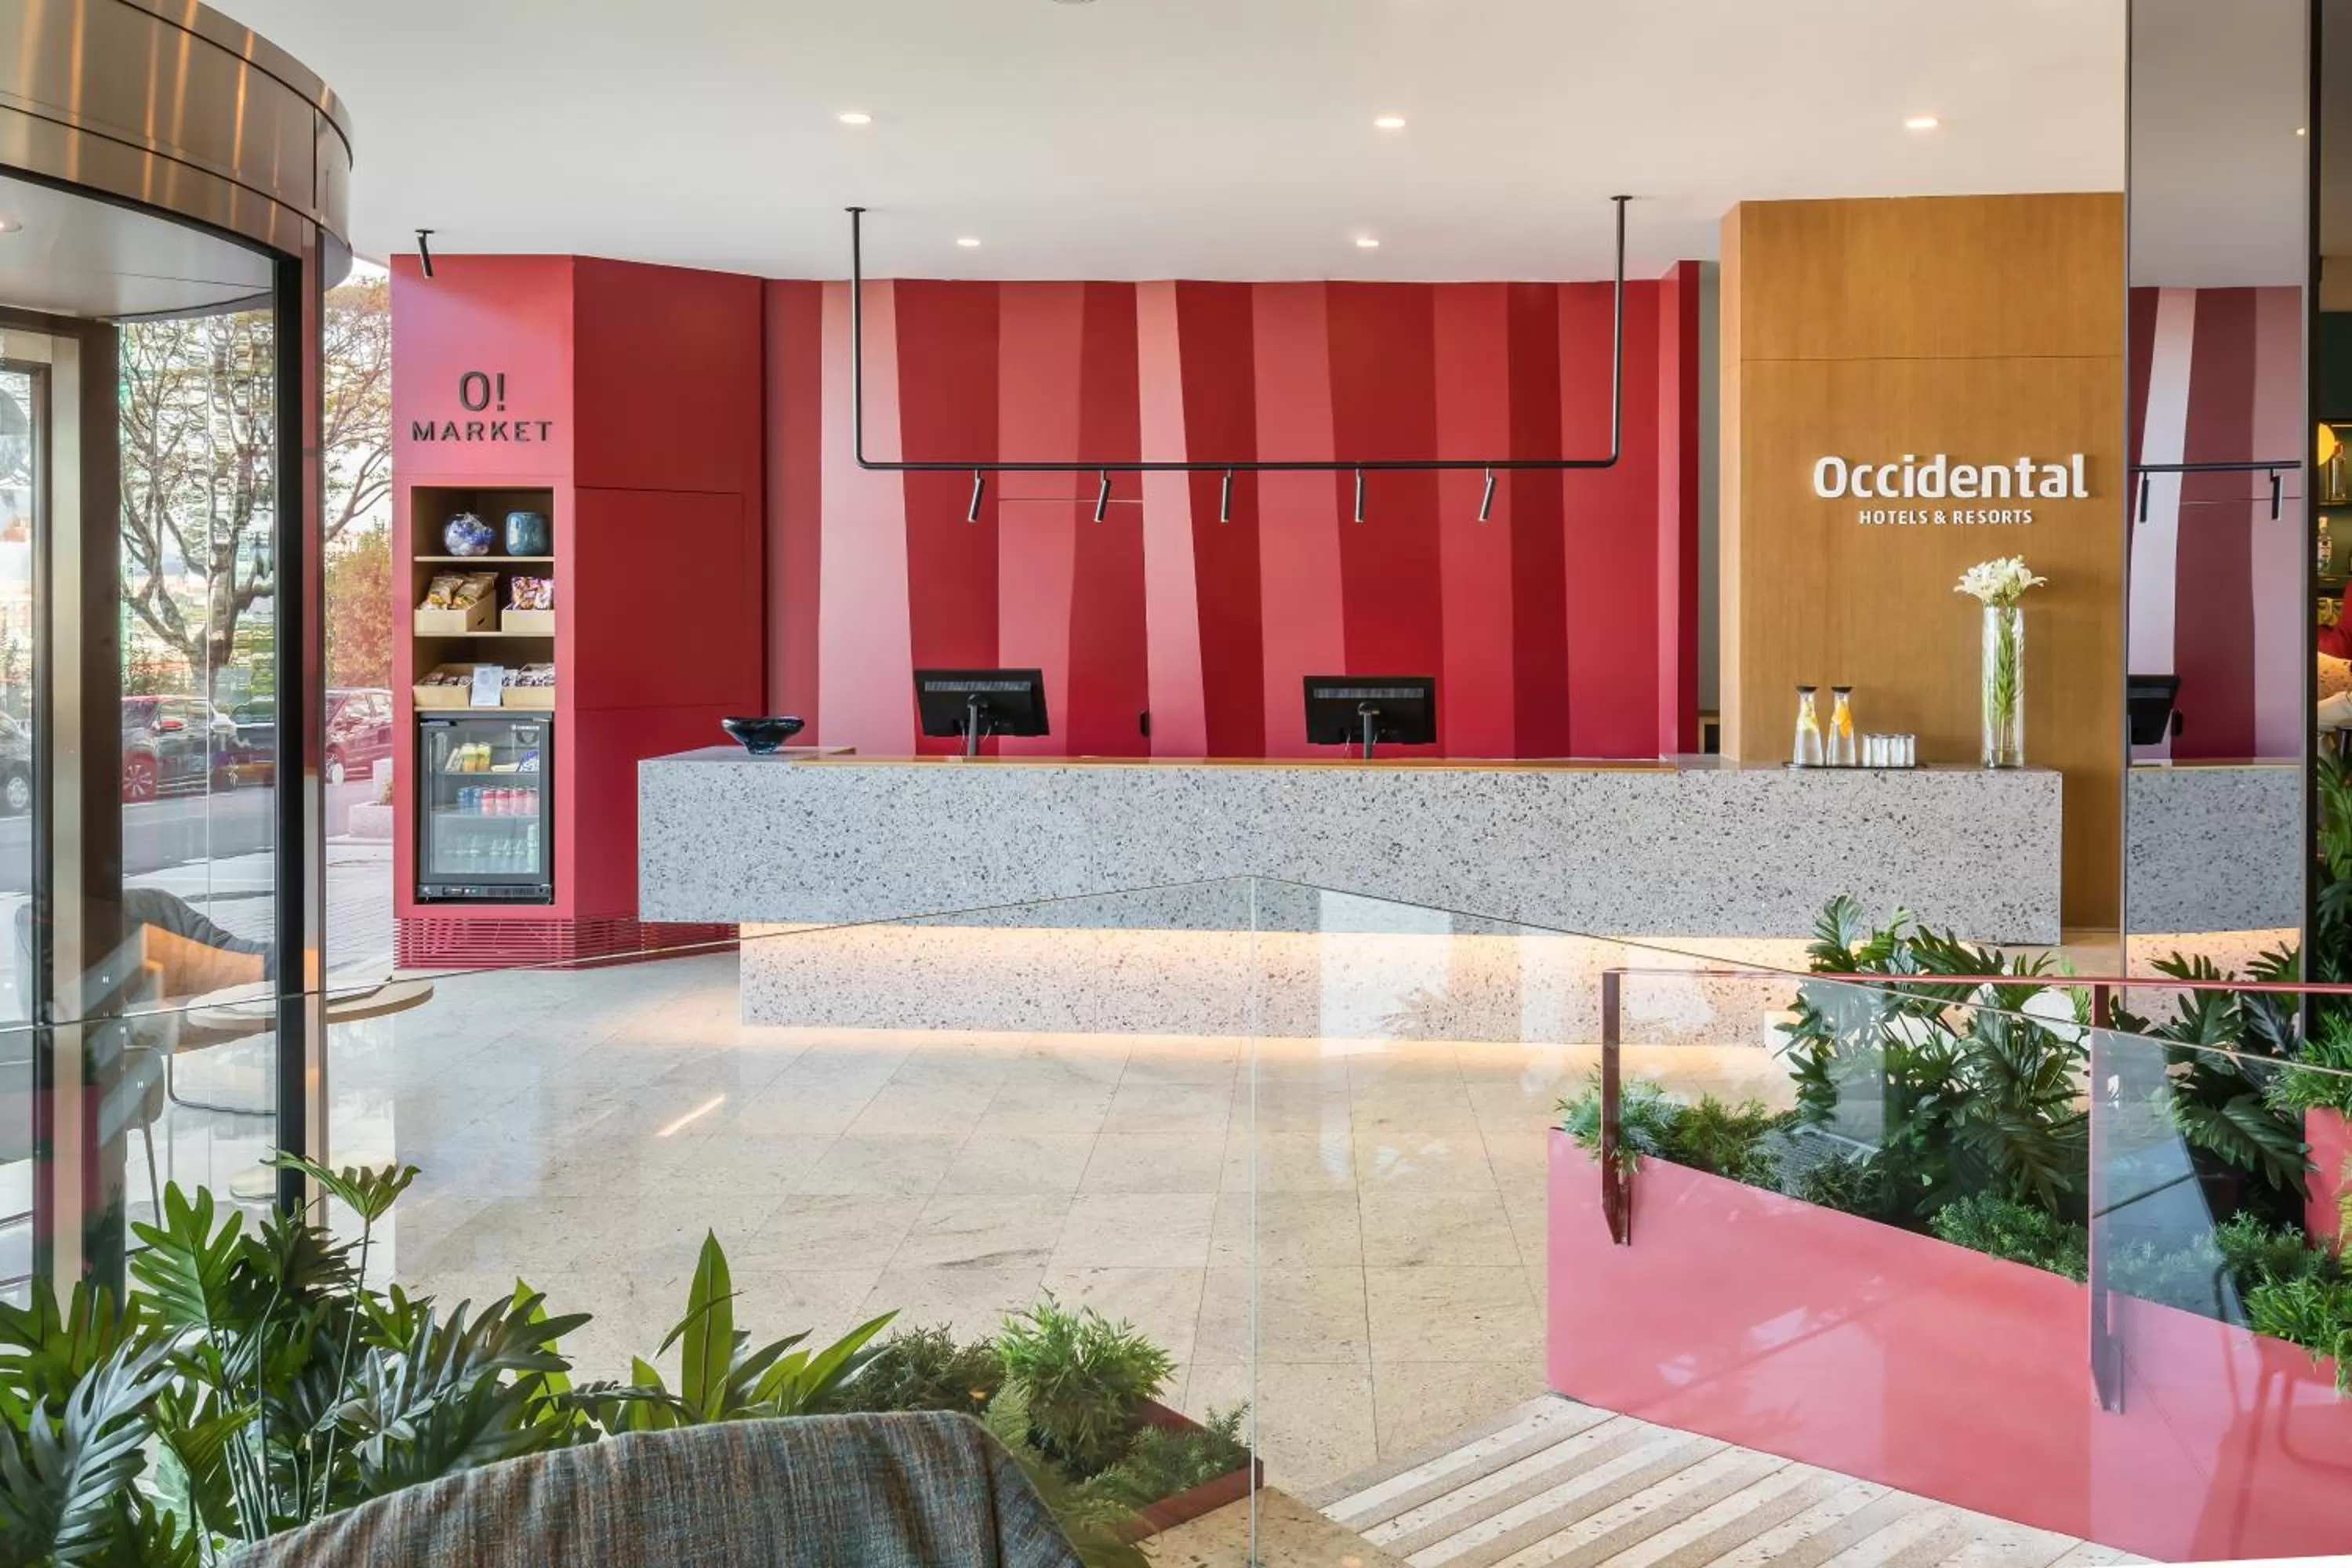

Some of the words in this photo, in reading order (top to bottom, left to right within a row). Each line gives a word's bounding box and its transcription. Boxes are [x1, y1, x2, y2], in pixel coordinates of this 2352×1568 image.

[459, 371, 506, 412] O!
[412, 421, 553, 441] MARKET
[1813, 453, 2089, 499] Occidental
[1858, 510, 1929, 524] HOTELS
[1934, 510, 1946, 524] &
[1953, 509, 2033, 524] RESORTS
